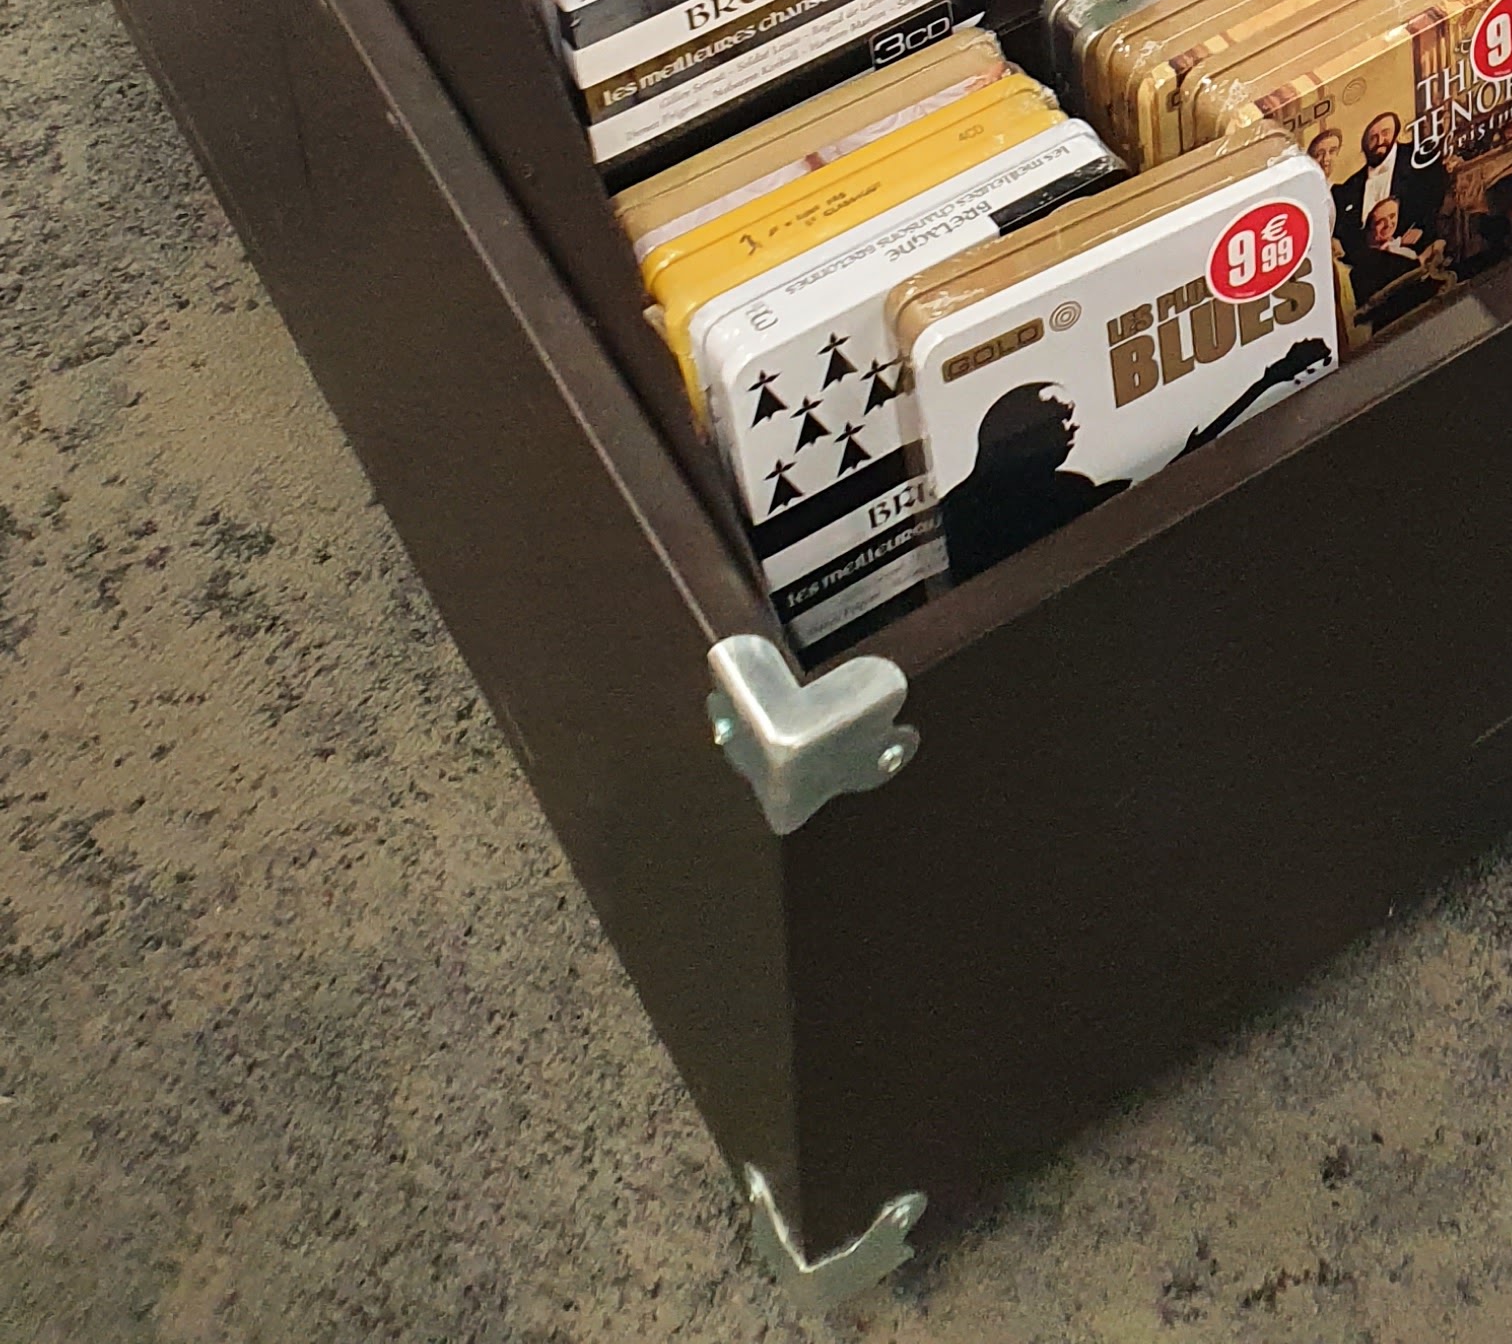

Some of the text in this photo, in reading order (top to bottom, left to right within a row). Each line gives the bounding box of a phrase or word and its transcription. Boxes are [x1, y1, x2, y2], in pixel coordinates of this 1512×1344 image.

[602, 79, 638, 110] les
[1107, 302, 1156, 342] LES
[1107, 255, 1317, 409] BLUES
[945, 325, 1041, 380] GOLD
